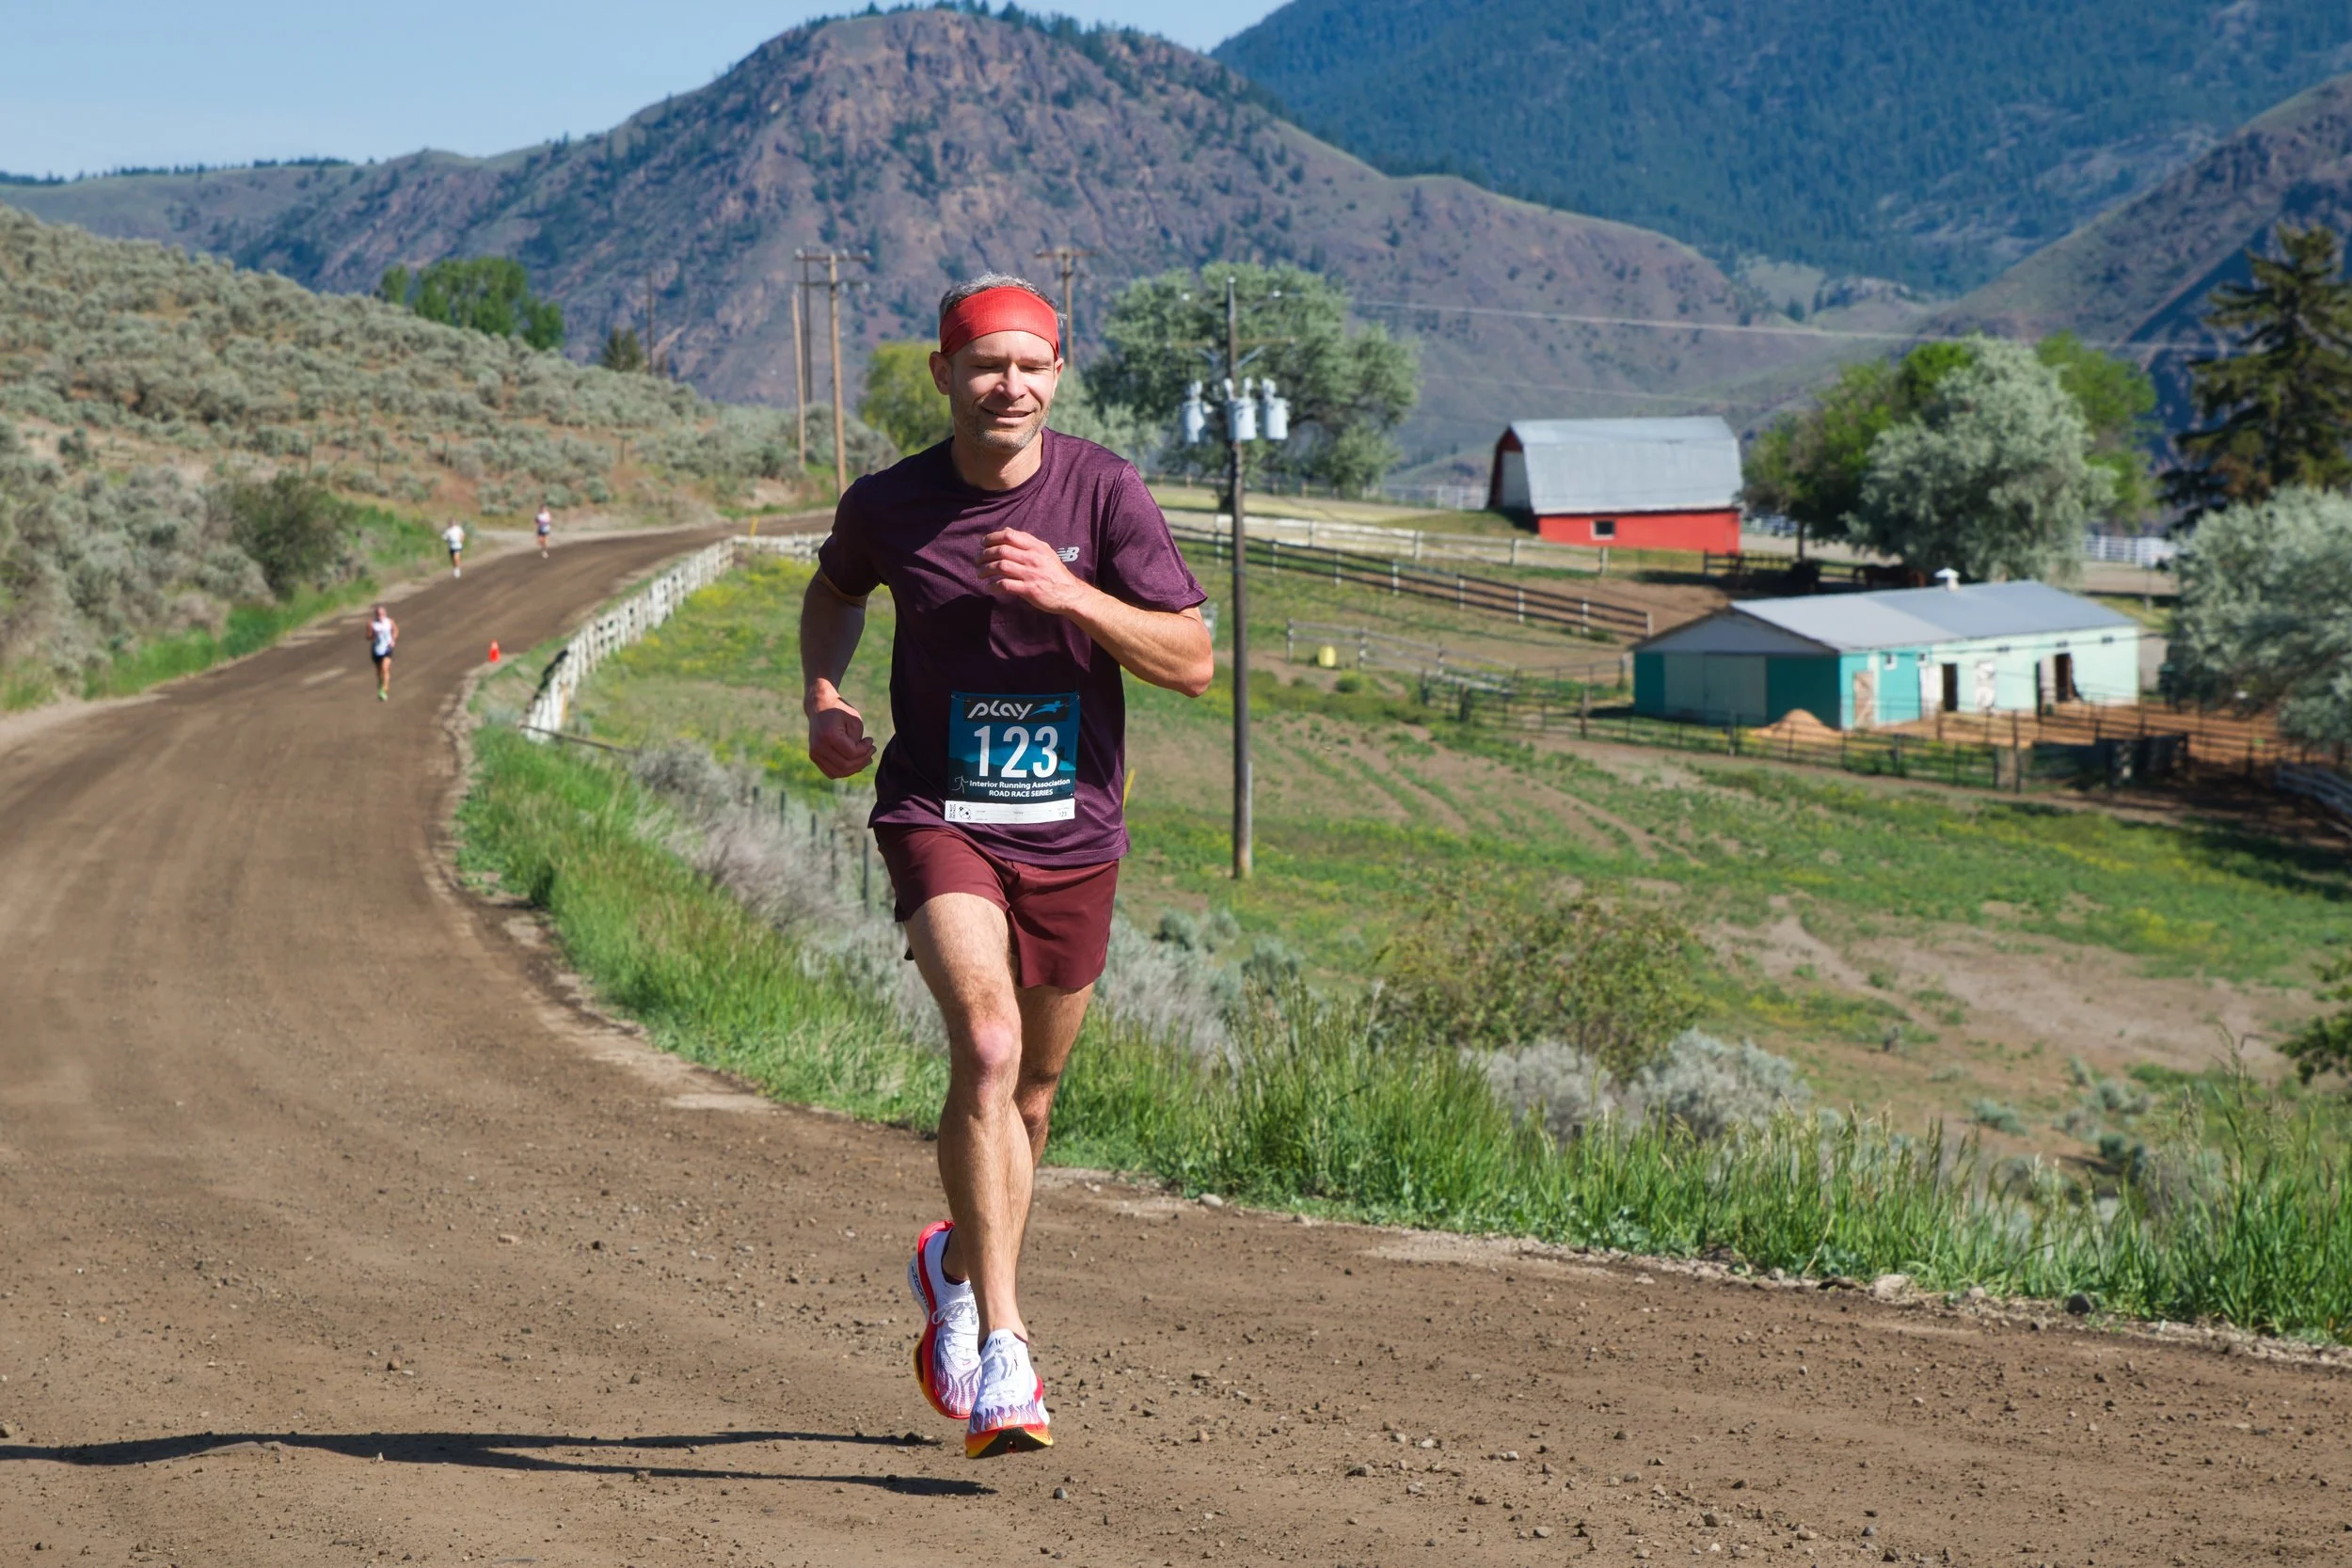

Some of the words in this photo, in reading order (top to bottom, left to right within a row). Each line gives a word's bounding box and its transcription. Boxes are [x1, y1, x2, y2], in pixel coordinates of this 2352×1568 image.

[974, 725, 1058, 778] 123
[969, 780, 997, 788] Interior
[999, 781, 1031, 790] Running
[1032, 779, 1071, 789] Association
